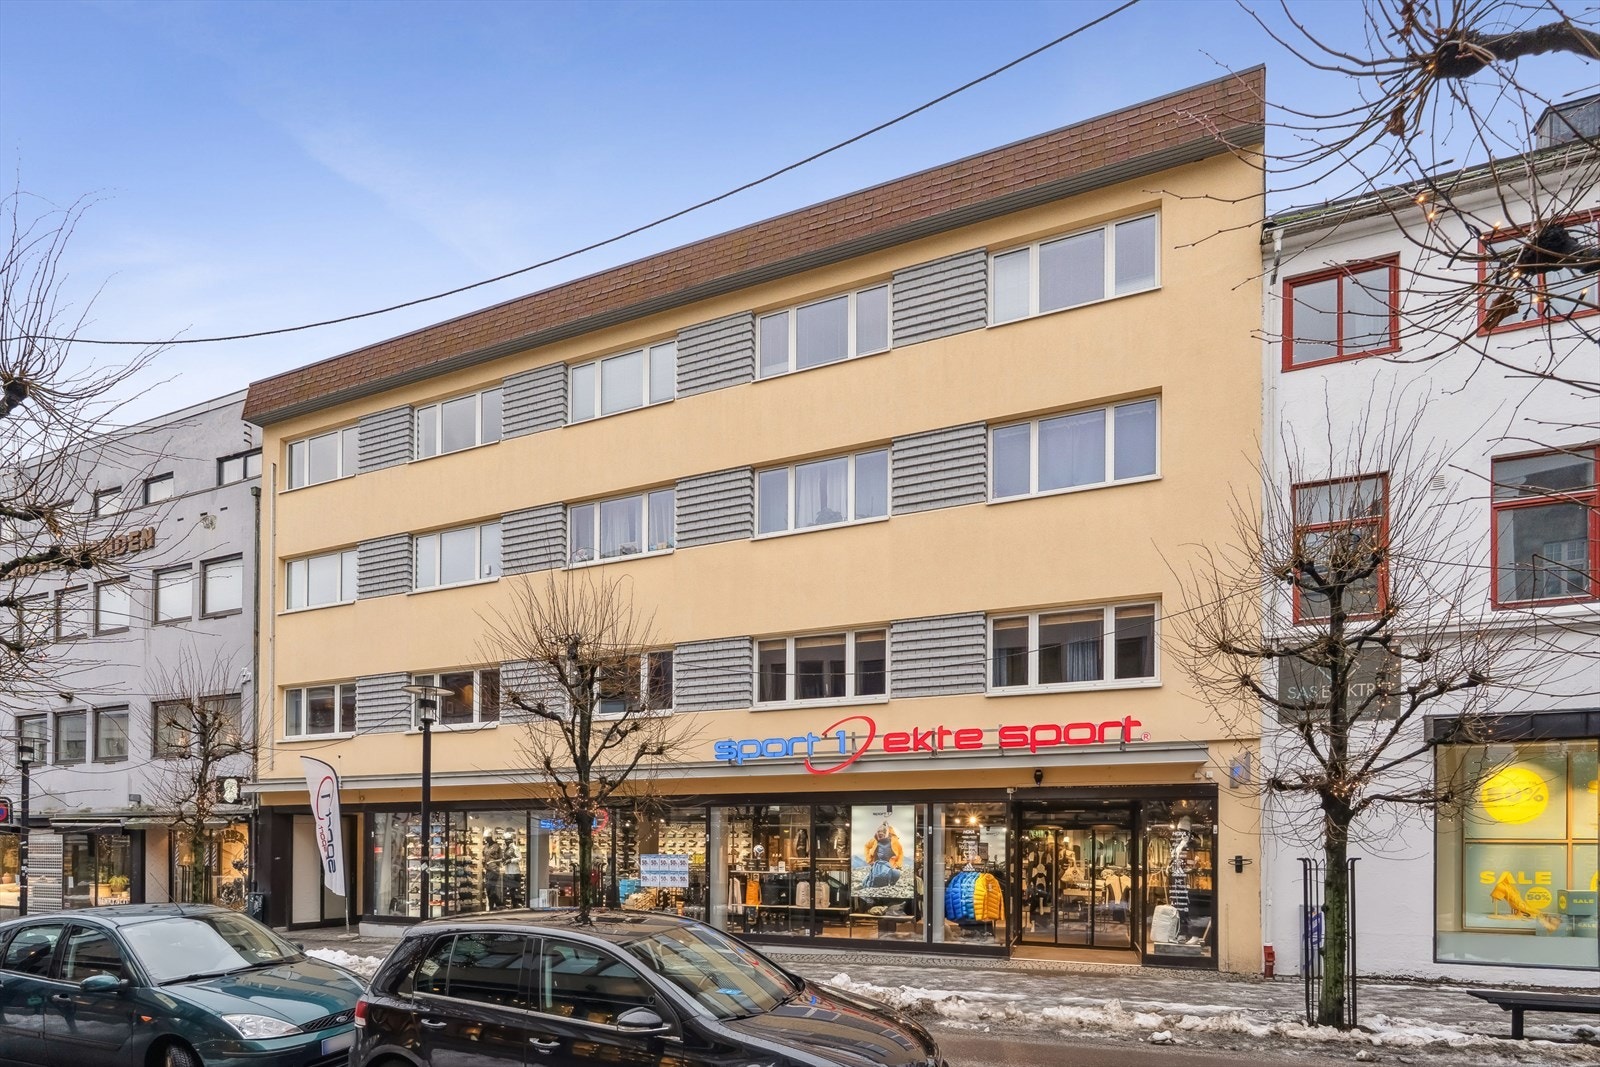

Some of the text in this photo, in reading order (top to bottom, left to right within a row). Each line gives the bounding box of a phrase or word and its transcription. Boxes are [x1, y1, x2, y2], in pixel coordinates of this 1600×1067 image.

[1287, 684, 1319, 701] SAS
[714, 715, 1142, 765] sport 1 ekte sport
[1479, 870, 1552, 885] SALE
